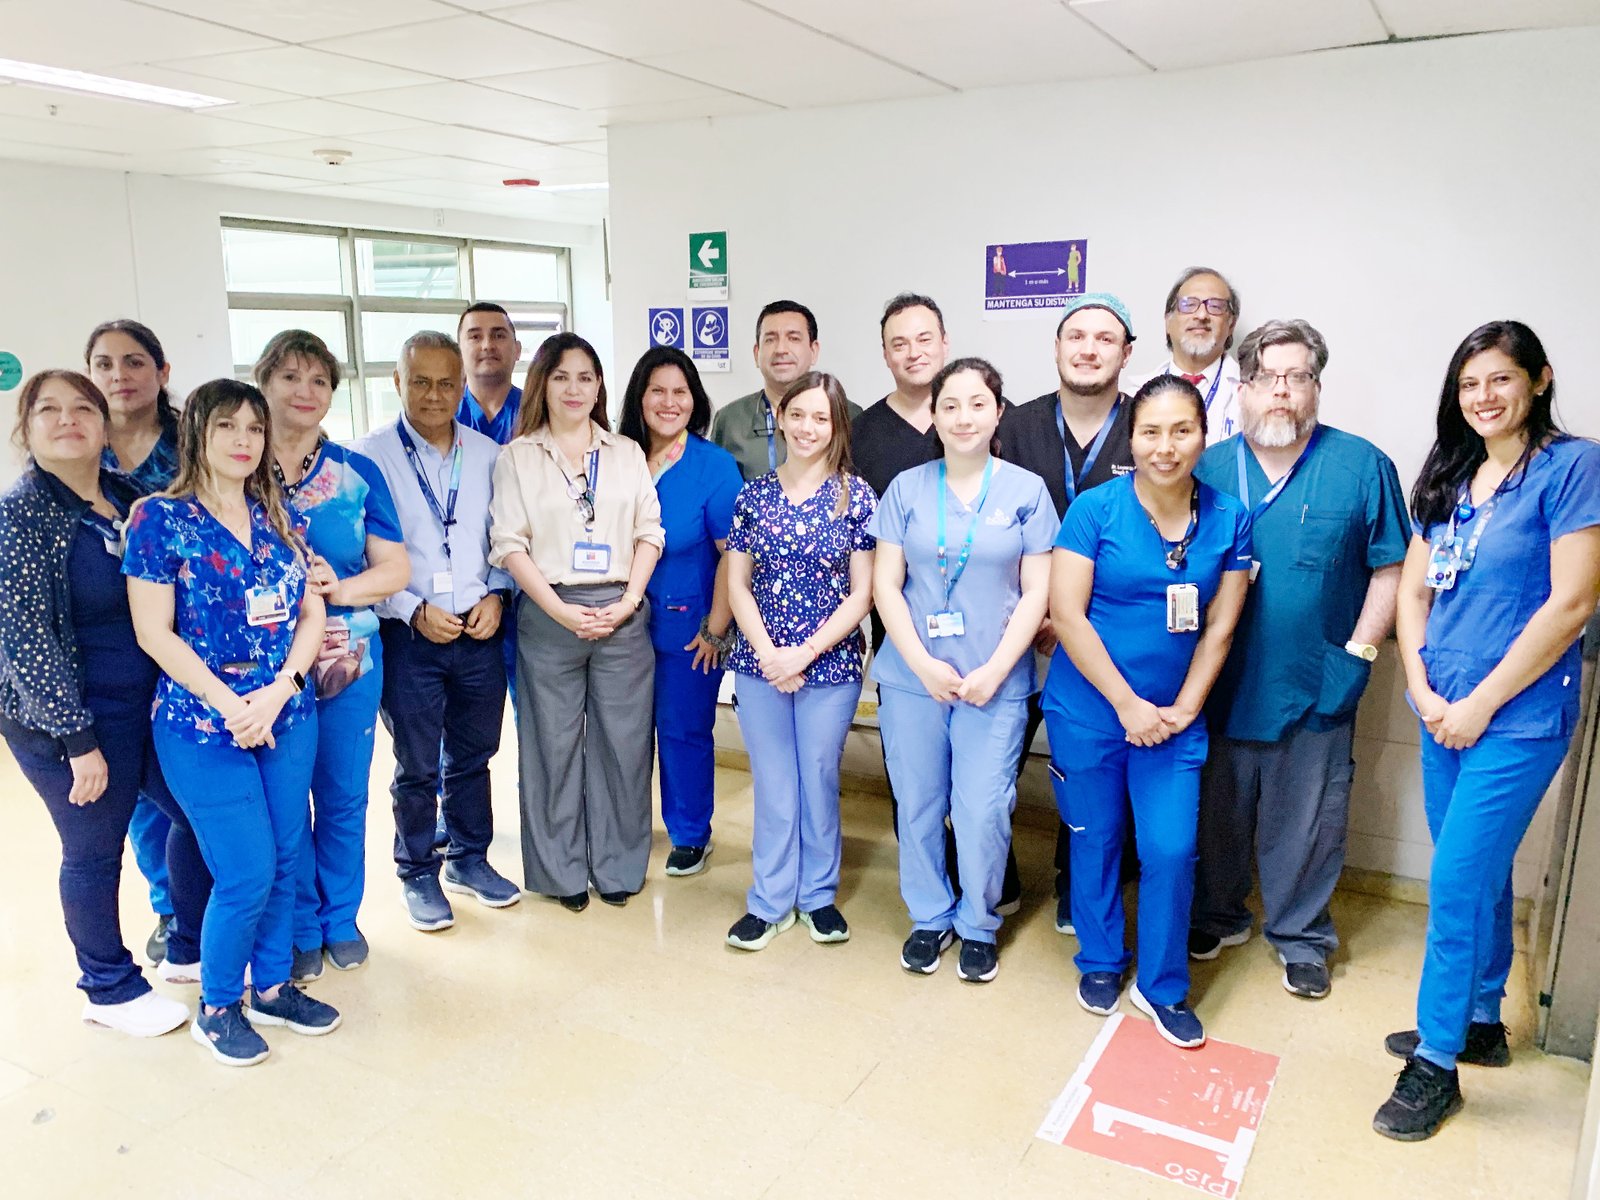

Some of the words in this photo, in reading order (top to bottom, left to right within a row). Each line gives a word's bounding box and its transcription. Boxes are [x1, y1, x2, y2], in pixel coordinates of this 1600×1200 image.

[987, 299, 1033, 309] MANTENGA
[1034, 298, 1045, 307] SU
[1164, 1162, 1229, 1197] Piso
